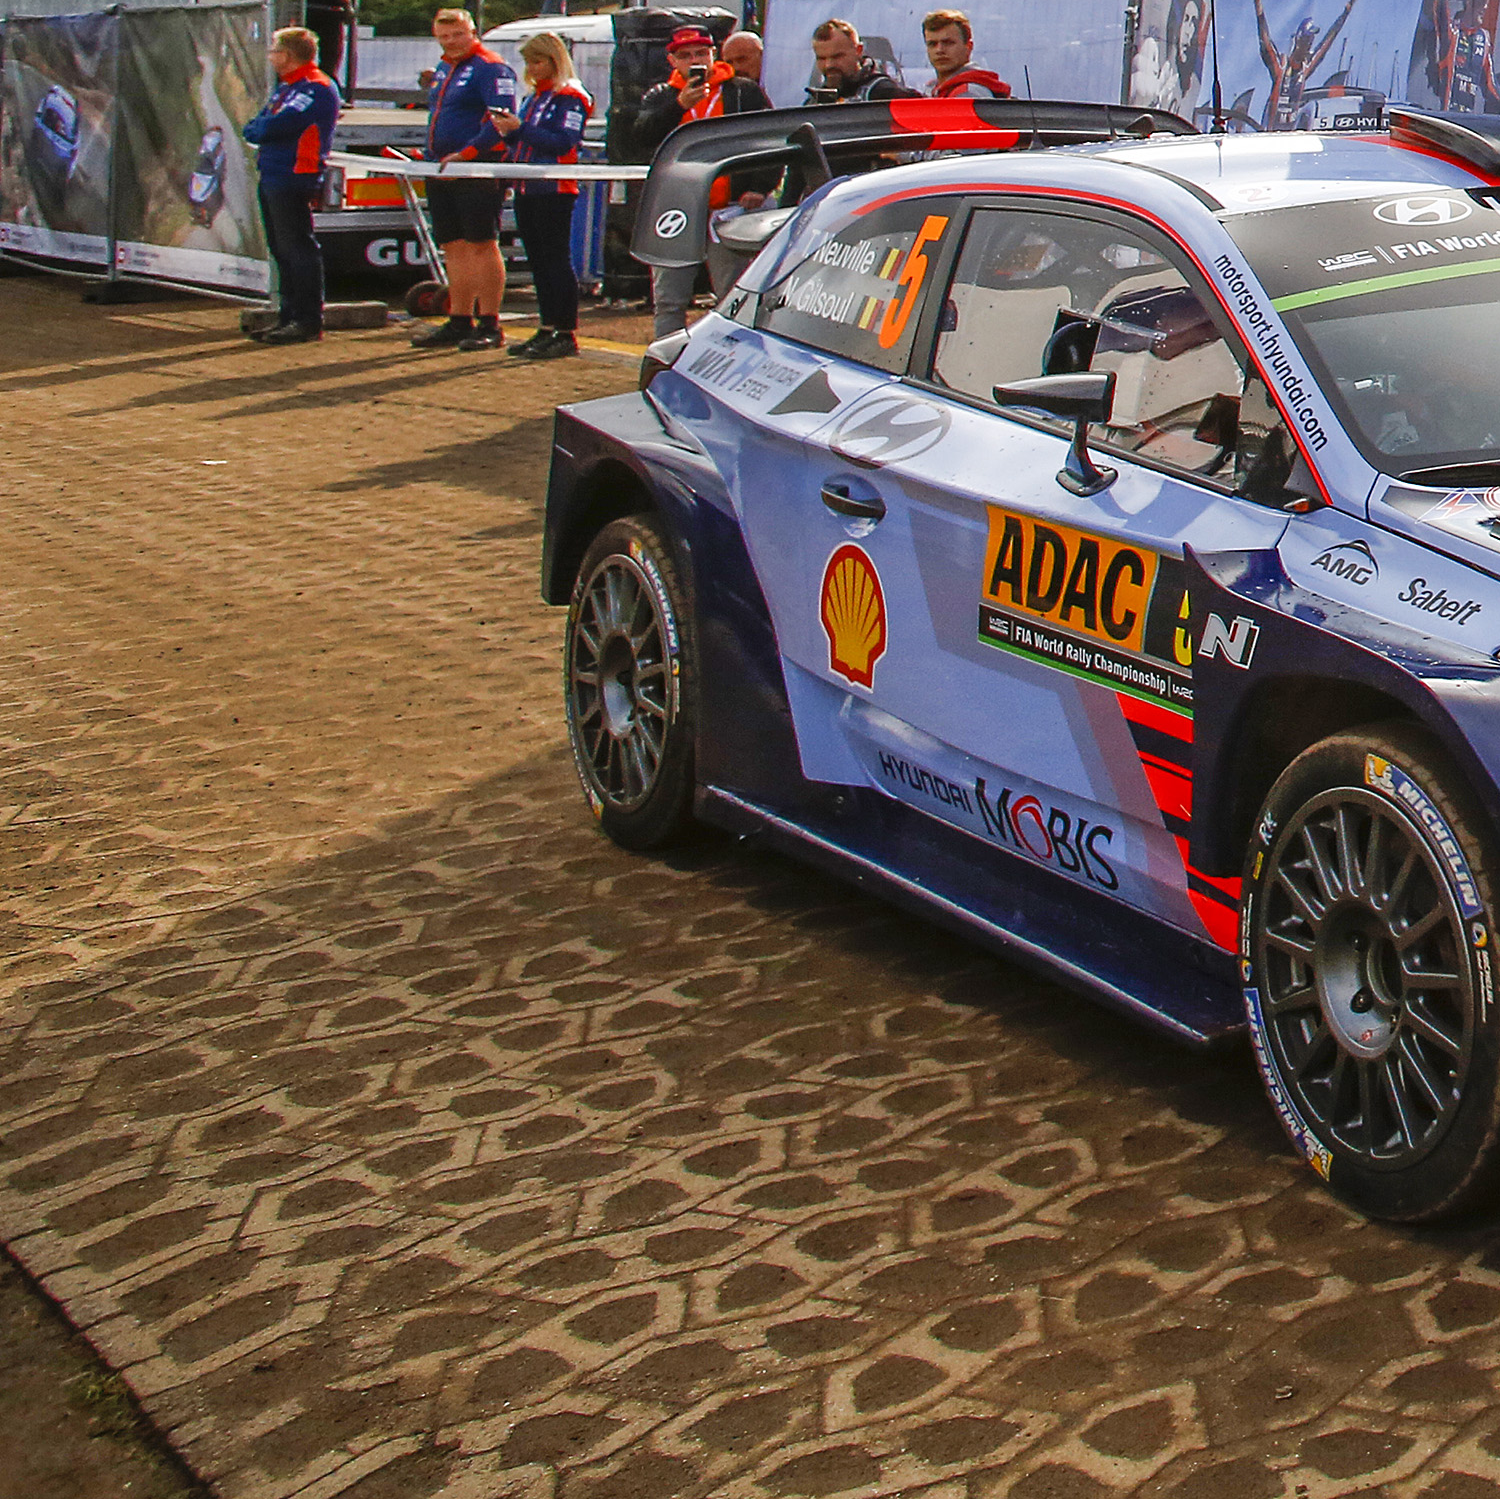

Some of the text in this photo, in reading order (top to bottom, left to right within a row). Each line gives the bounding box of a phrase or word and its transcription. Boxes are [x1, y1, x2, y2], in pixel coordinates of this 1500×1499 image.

[812, 231, 876, 275] Neuville
[878, 214, 950, 349] 5
[1390, 240, 1440, 260] FIA
[796, 277, 856, 324] Gilsoul
[1213, 253, 1329, 452] motorsport.hyundai.com
[988, 514, 1146, 641] ADAC
[1310, 552, 1374, 586] AMG
[1397, 577, 1483, 626] Sabelt
[1015, 626, 1033, 646] FIA
[1034, 631, 1064, 658] World
[1066, 642, 1093, 669] Rally
[1093, 653, 1167, 695] Championship
[878, 750, 975, 816] HYUNDAI
[974, 776, 1120, 891] MOBIS
[1398, 779, 1480, 909] MICHELIN
